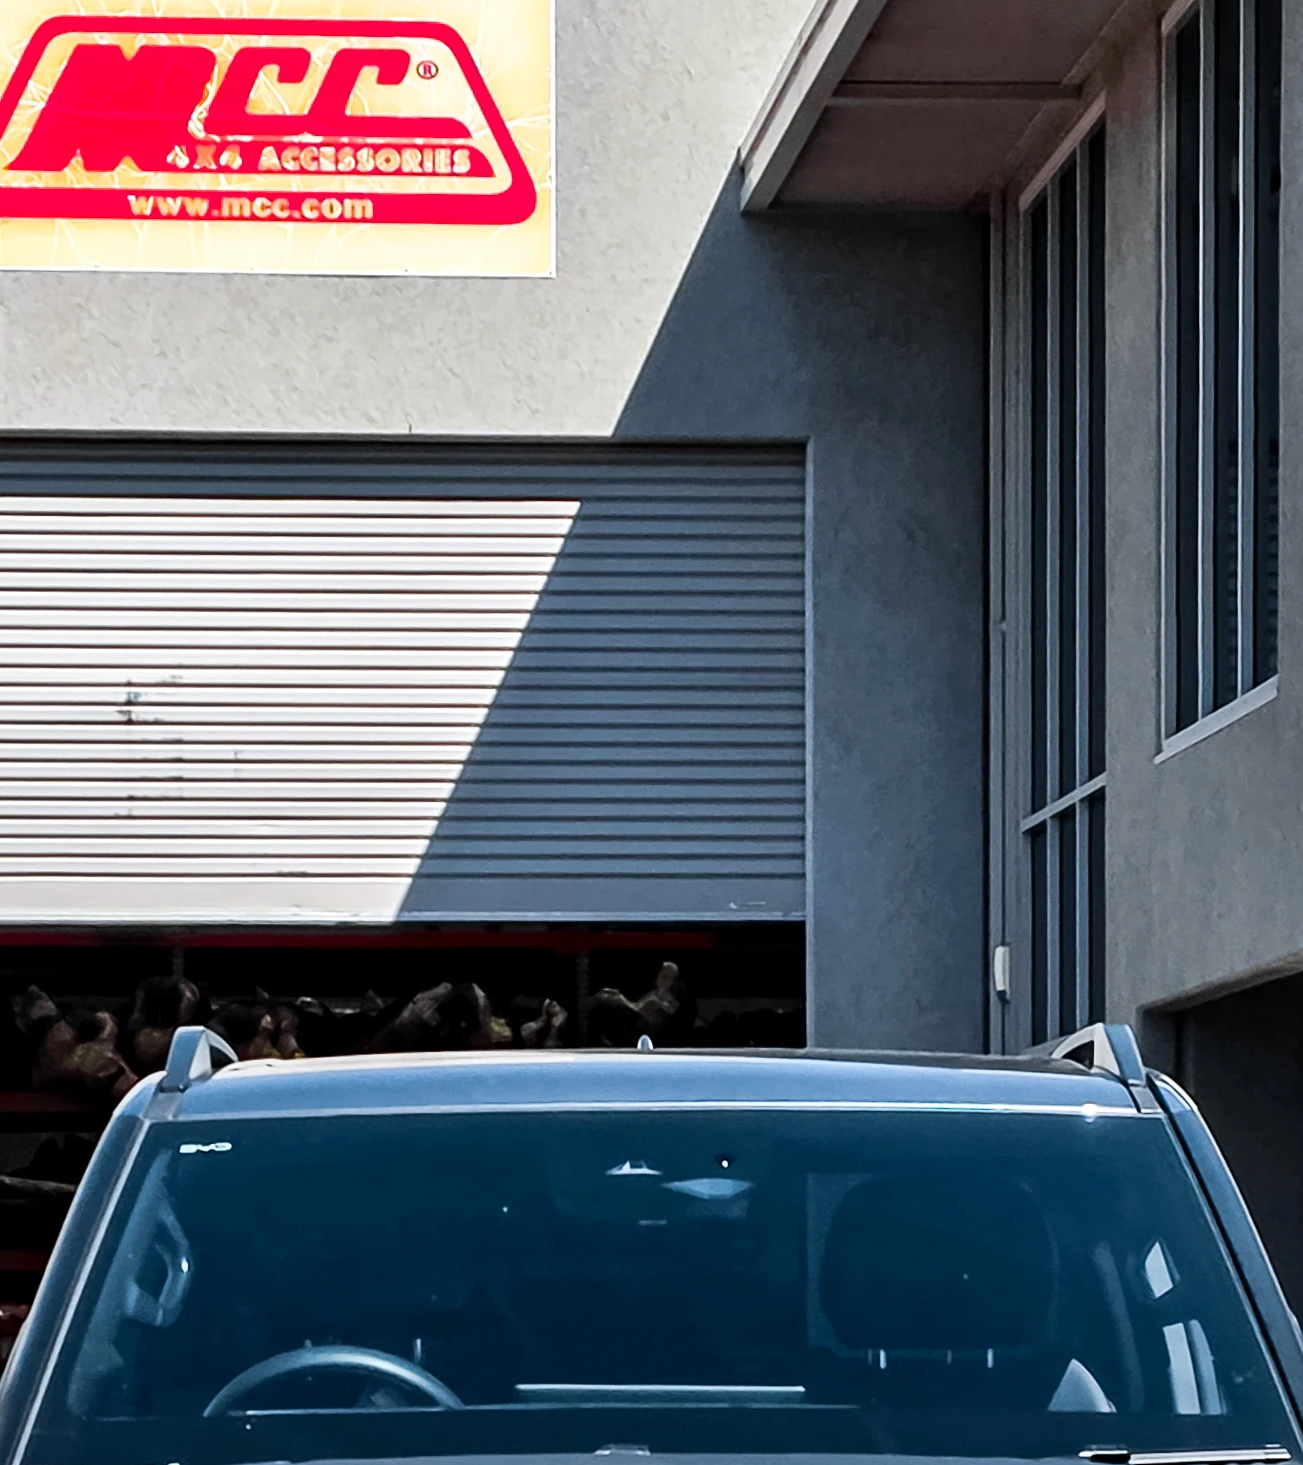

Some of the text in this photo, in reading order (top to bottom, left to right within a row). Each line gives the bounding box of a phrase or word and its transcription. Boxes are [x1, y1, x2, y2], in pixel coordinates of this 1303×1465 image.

[2, 44, 472, 171] MCC
[258, 146, 471, 174] ACCESSORIES
[128, 195, 373, 221] www.mcc.com
